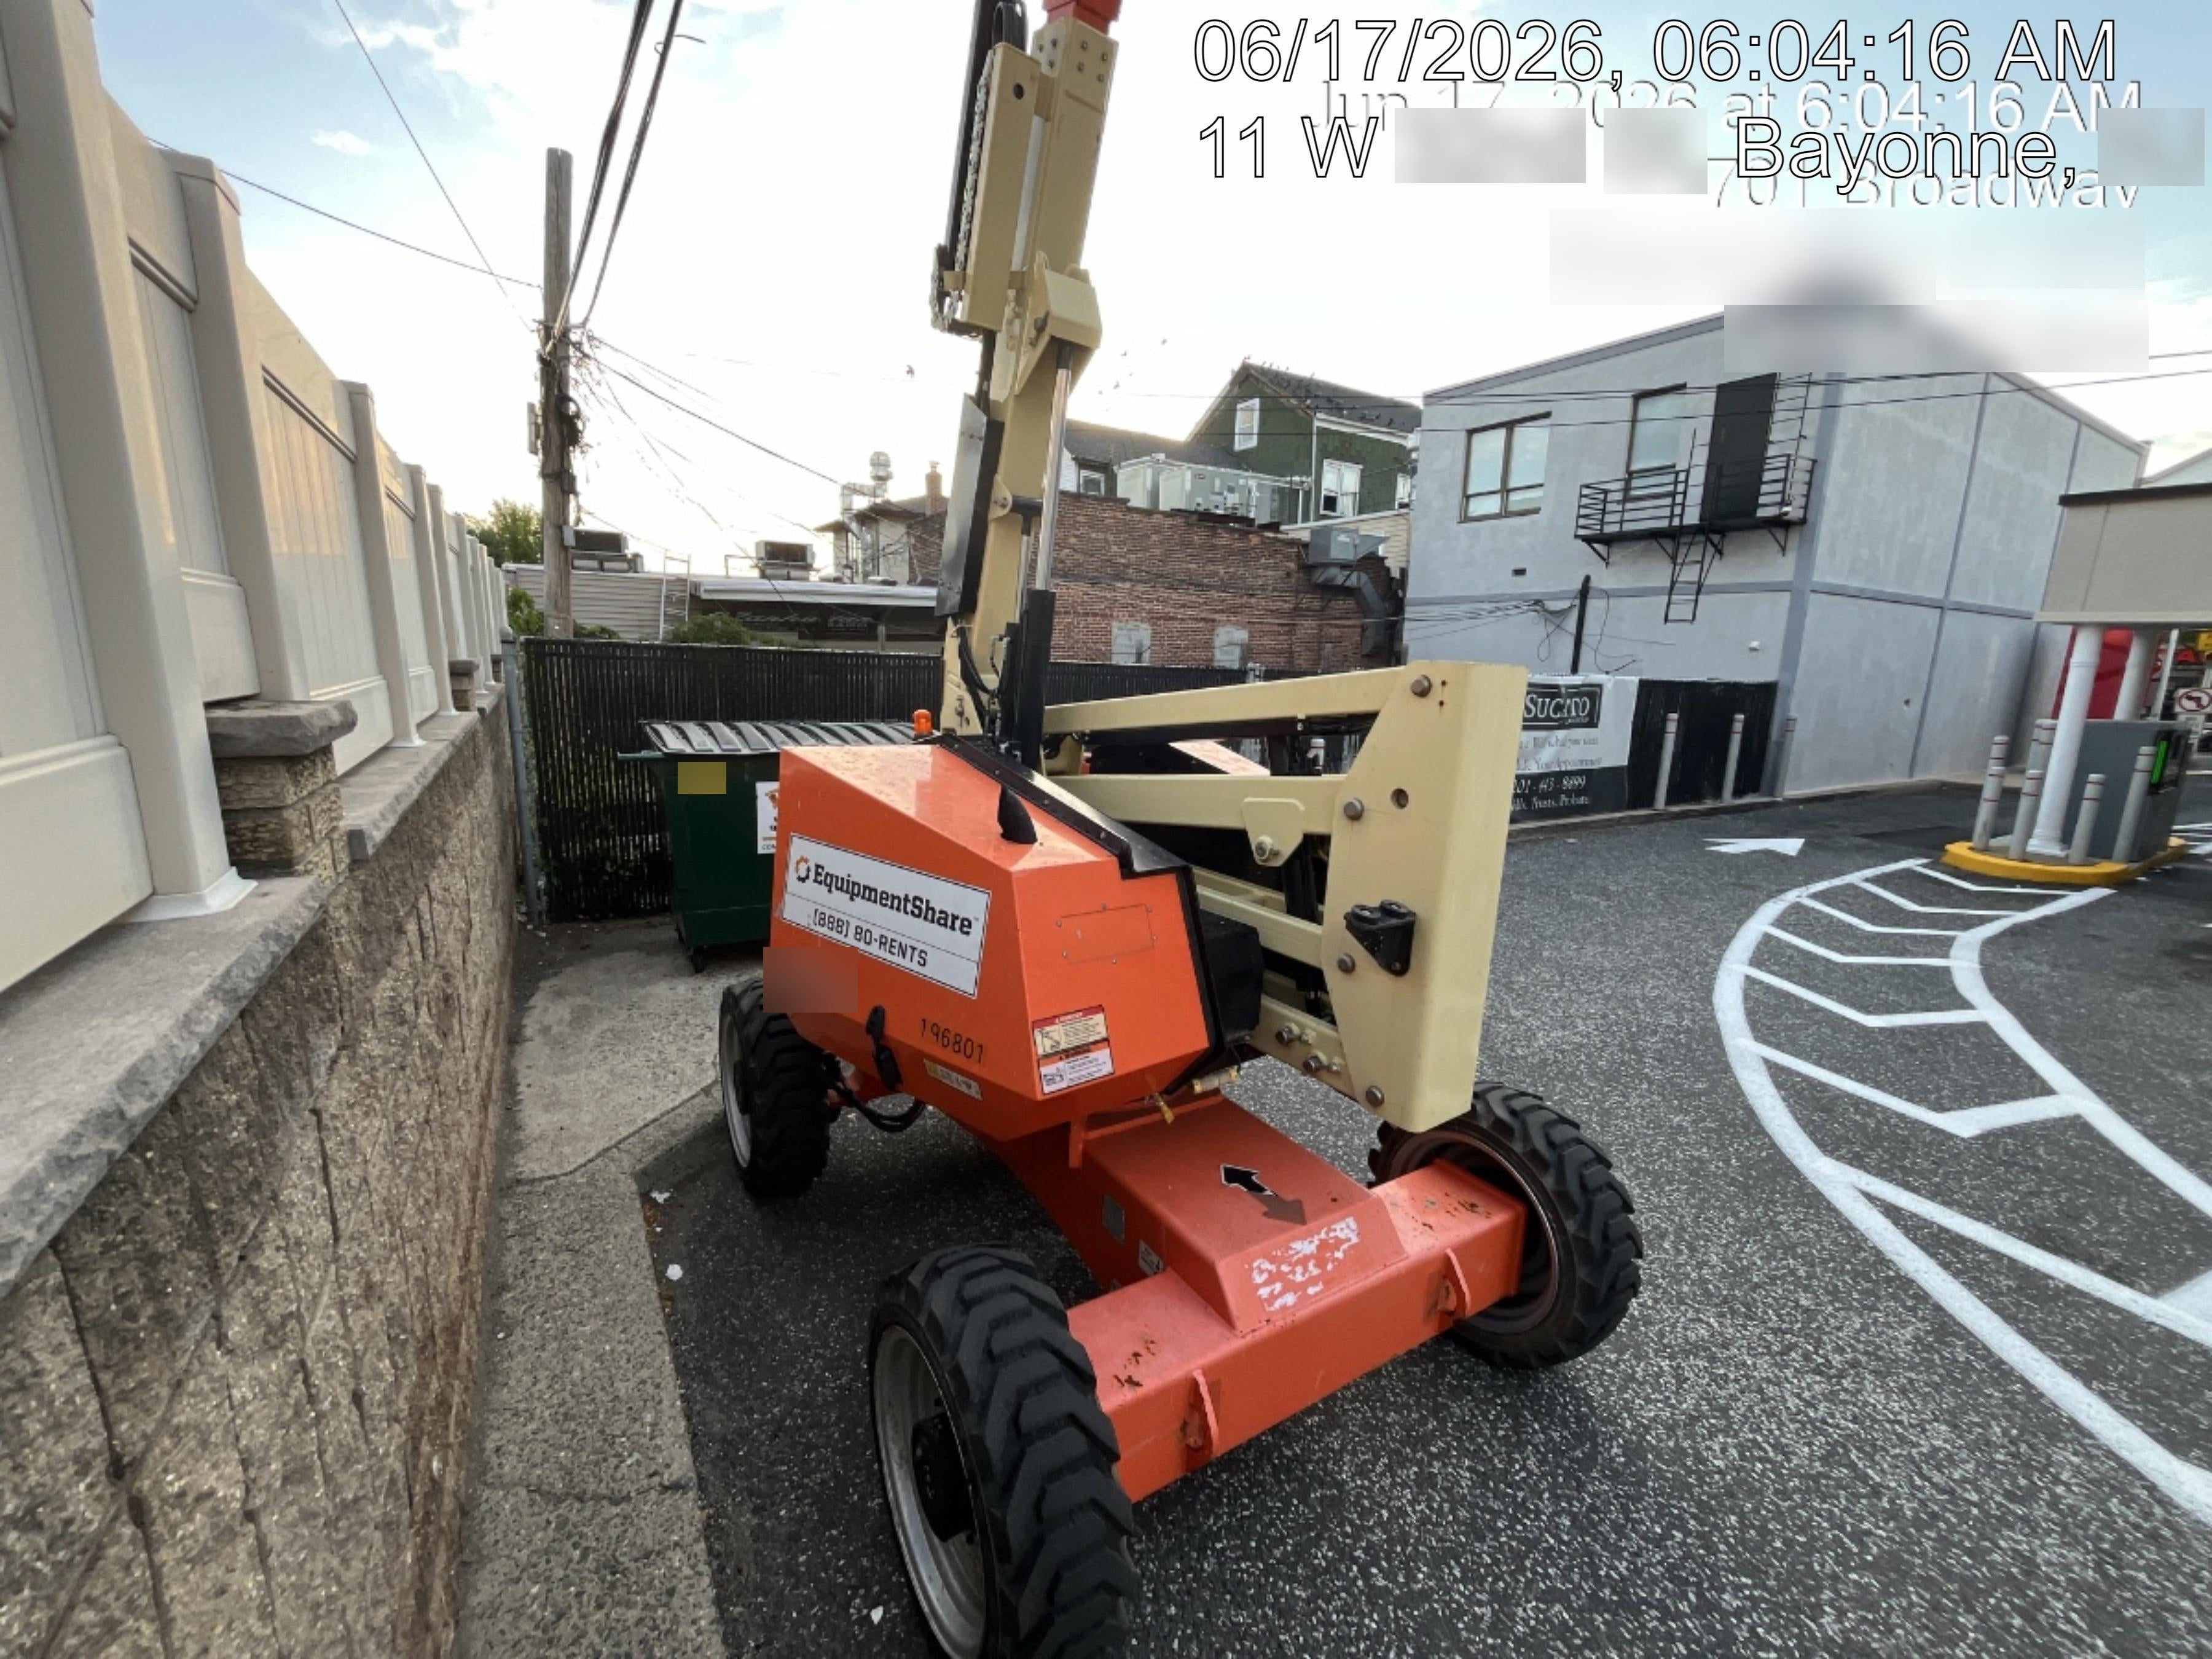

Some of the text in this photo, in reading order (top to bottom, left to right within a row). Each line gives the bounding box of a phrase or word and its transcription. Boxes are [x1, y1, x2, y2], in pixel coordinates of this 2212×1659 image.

[812, 863, 973, 936] EquipmentShare
[813, 908, 928, 967] (888) 80-RENTS
[921, 1018, 984, 1064] 196801
